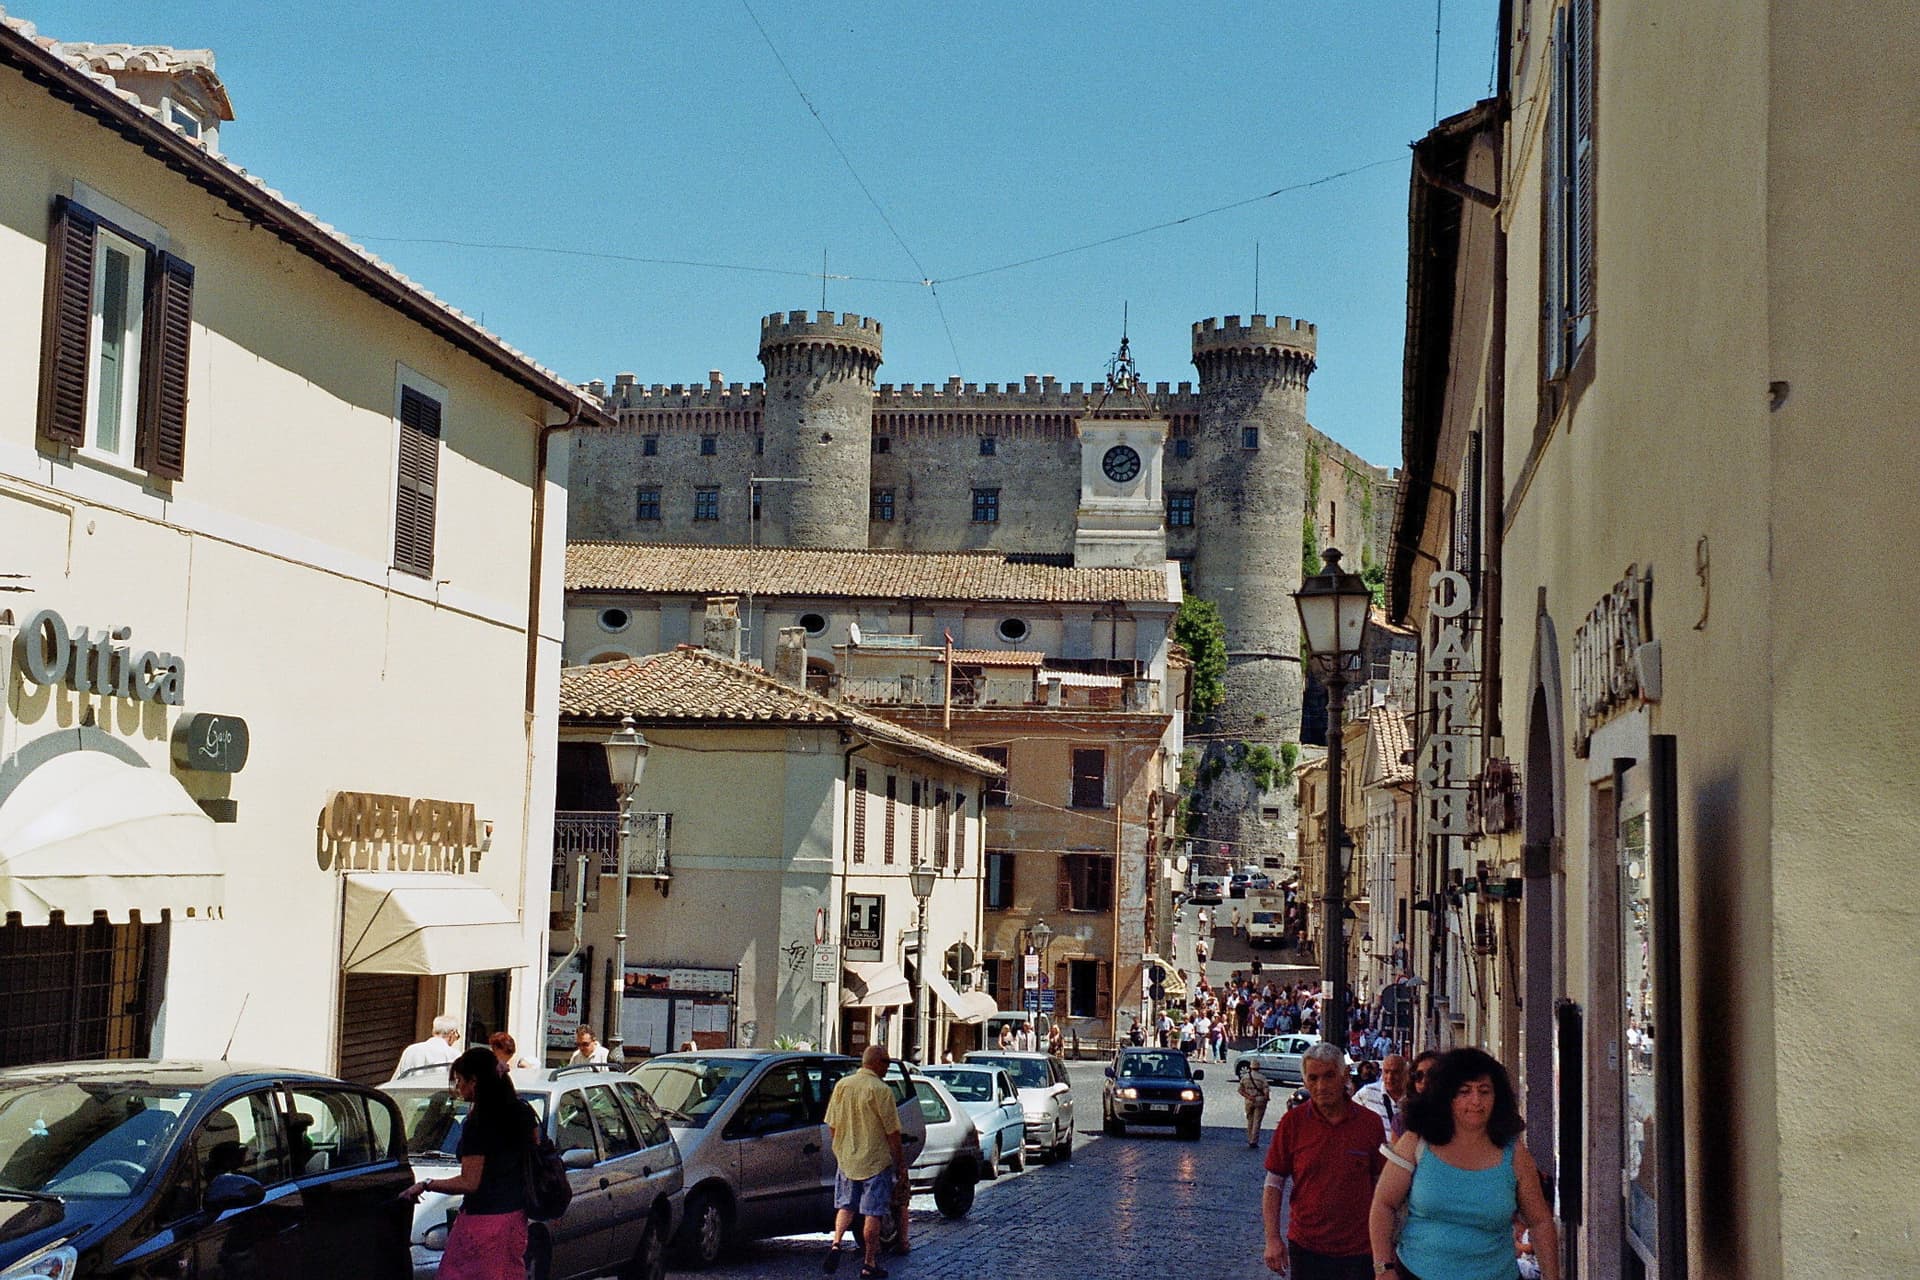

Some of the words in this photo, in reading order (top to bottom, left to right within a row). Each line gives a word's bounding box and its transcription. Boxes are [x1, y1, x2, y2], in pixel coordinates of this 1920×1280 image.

[22, 609, 186, 706] Ottica
[327, 790, 478, 848] OREFICERIA
[853, 897, 878, 930] T
[848, 939, 879, 948] LOTTO
[553, 997, 578, 1008] ROCK
